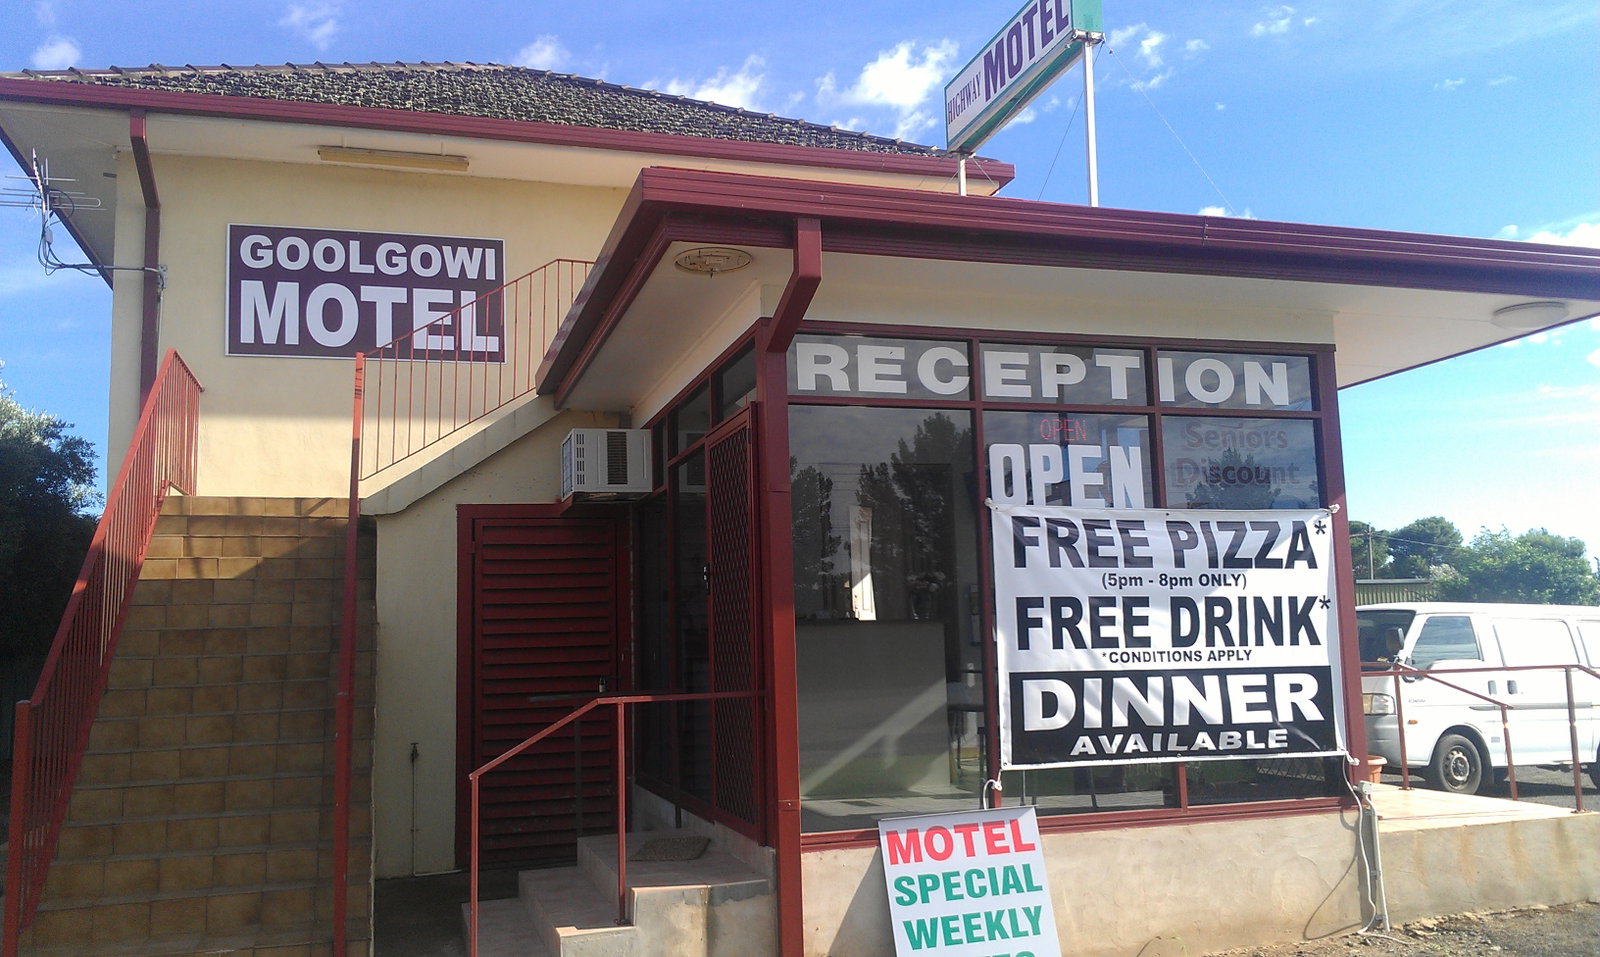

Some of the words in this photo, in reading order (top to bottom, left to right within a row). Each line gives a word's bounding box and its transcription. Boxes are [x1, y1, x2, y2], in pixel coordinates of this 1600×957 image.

[947, 71, 982, 125] HIGHWAY
[983, 0, 1069, 102] MOTEL
[240, 234, 496, 281] GOOLGOWI
[240, 280, 499, 352] MOTEL
[796, 342, 1290, 406] RECEPTION
[1040, 418, 1087, 441] OPEN
[1184, 420, 1289, 449] Seniors
[989, 443, 1145, 509] OPEN
[1172, 457, 1302, 487] Discount
[1011, 515, 1154, 569] FREE
[1101, 573, 1143, 589] (5pm
[1159, 573, 1193, 589] 8pm
[1198, 573, 1247, 590] ONLY)
[1015, 595, 1152, 651] FREE
[1207, 649, 1253, 662] APPLY
[1021, 673, 1326, 732] DINNER
[1070, 728, 1288, 756] AVAILABLE
[885, 818, 1036, 866] MOTEL
[893, 863, 1043, 907] SPECIAL
[902, 905, 1042, 951] WEEKLY
